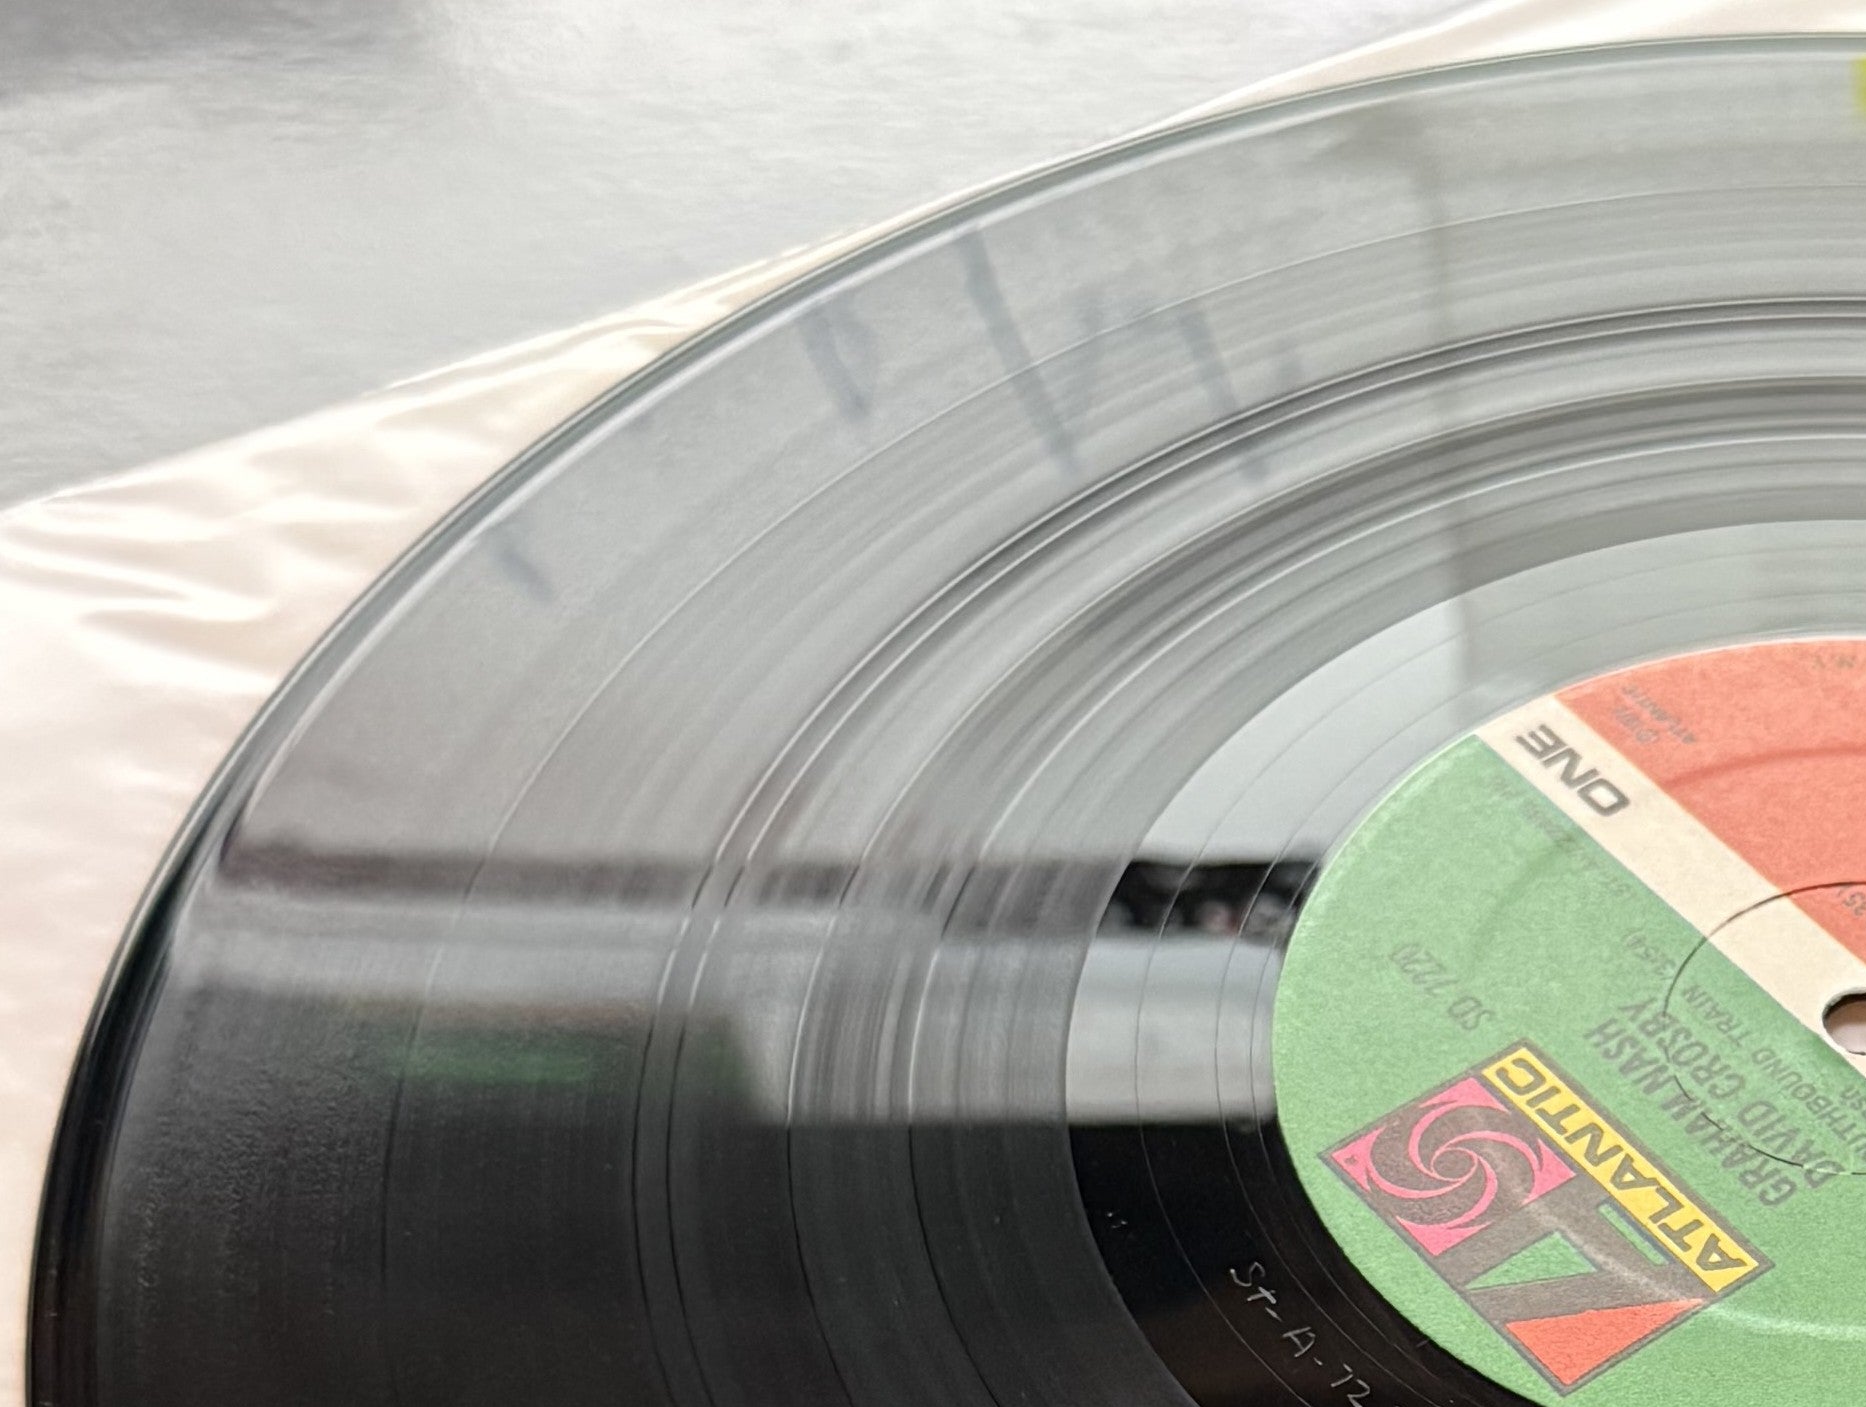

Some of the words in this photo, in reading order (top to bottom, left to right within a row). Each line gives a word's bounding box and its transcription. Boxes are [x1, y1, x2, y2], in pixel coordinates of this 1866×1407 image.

[1514, 723, 1632, 818] ONE
[1384, 938, 1460, 996] 7220
[1443, 992, 1498, 1031] SD
[1579, 1017, 1680, 1096] NASH
[1614, 991, 1752, 1103] CROSBY
[1677, 983, 1757, 1048] TRAIN
[1490, 1054, 1748, 1271] ATLANTIC
[1657, 1087, 1804, 1209] GRAHAM
[1731, 1095, 1849, 1189] DAVID
